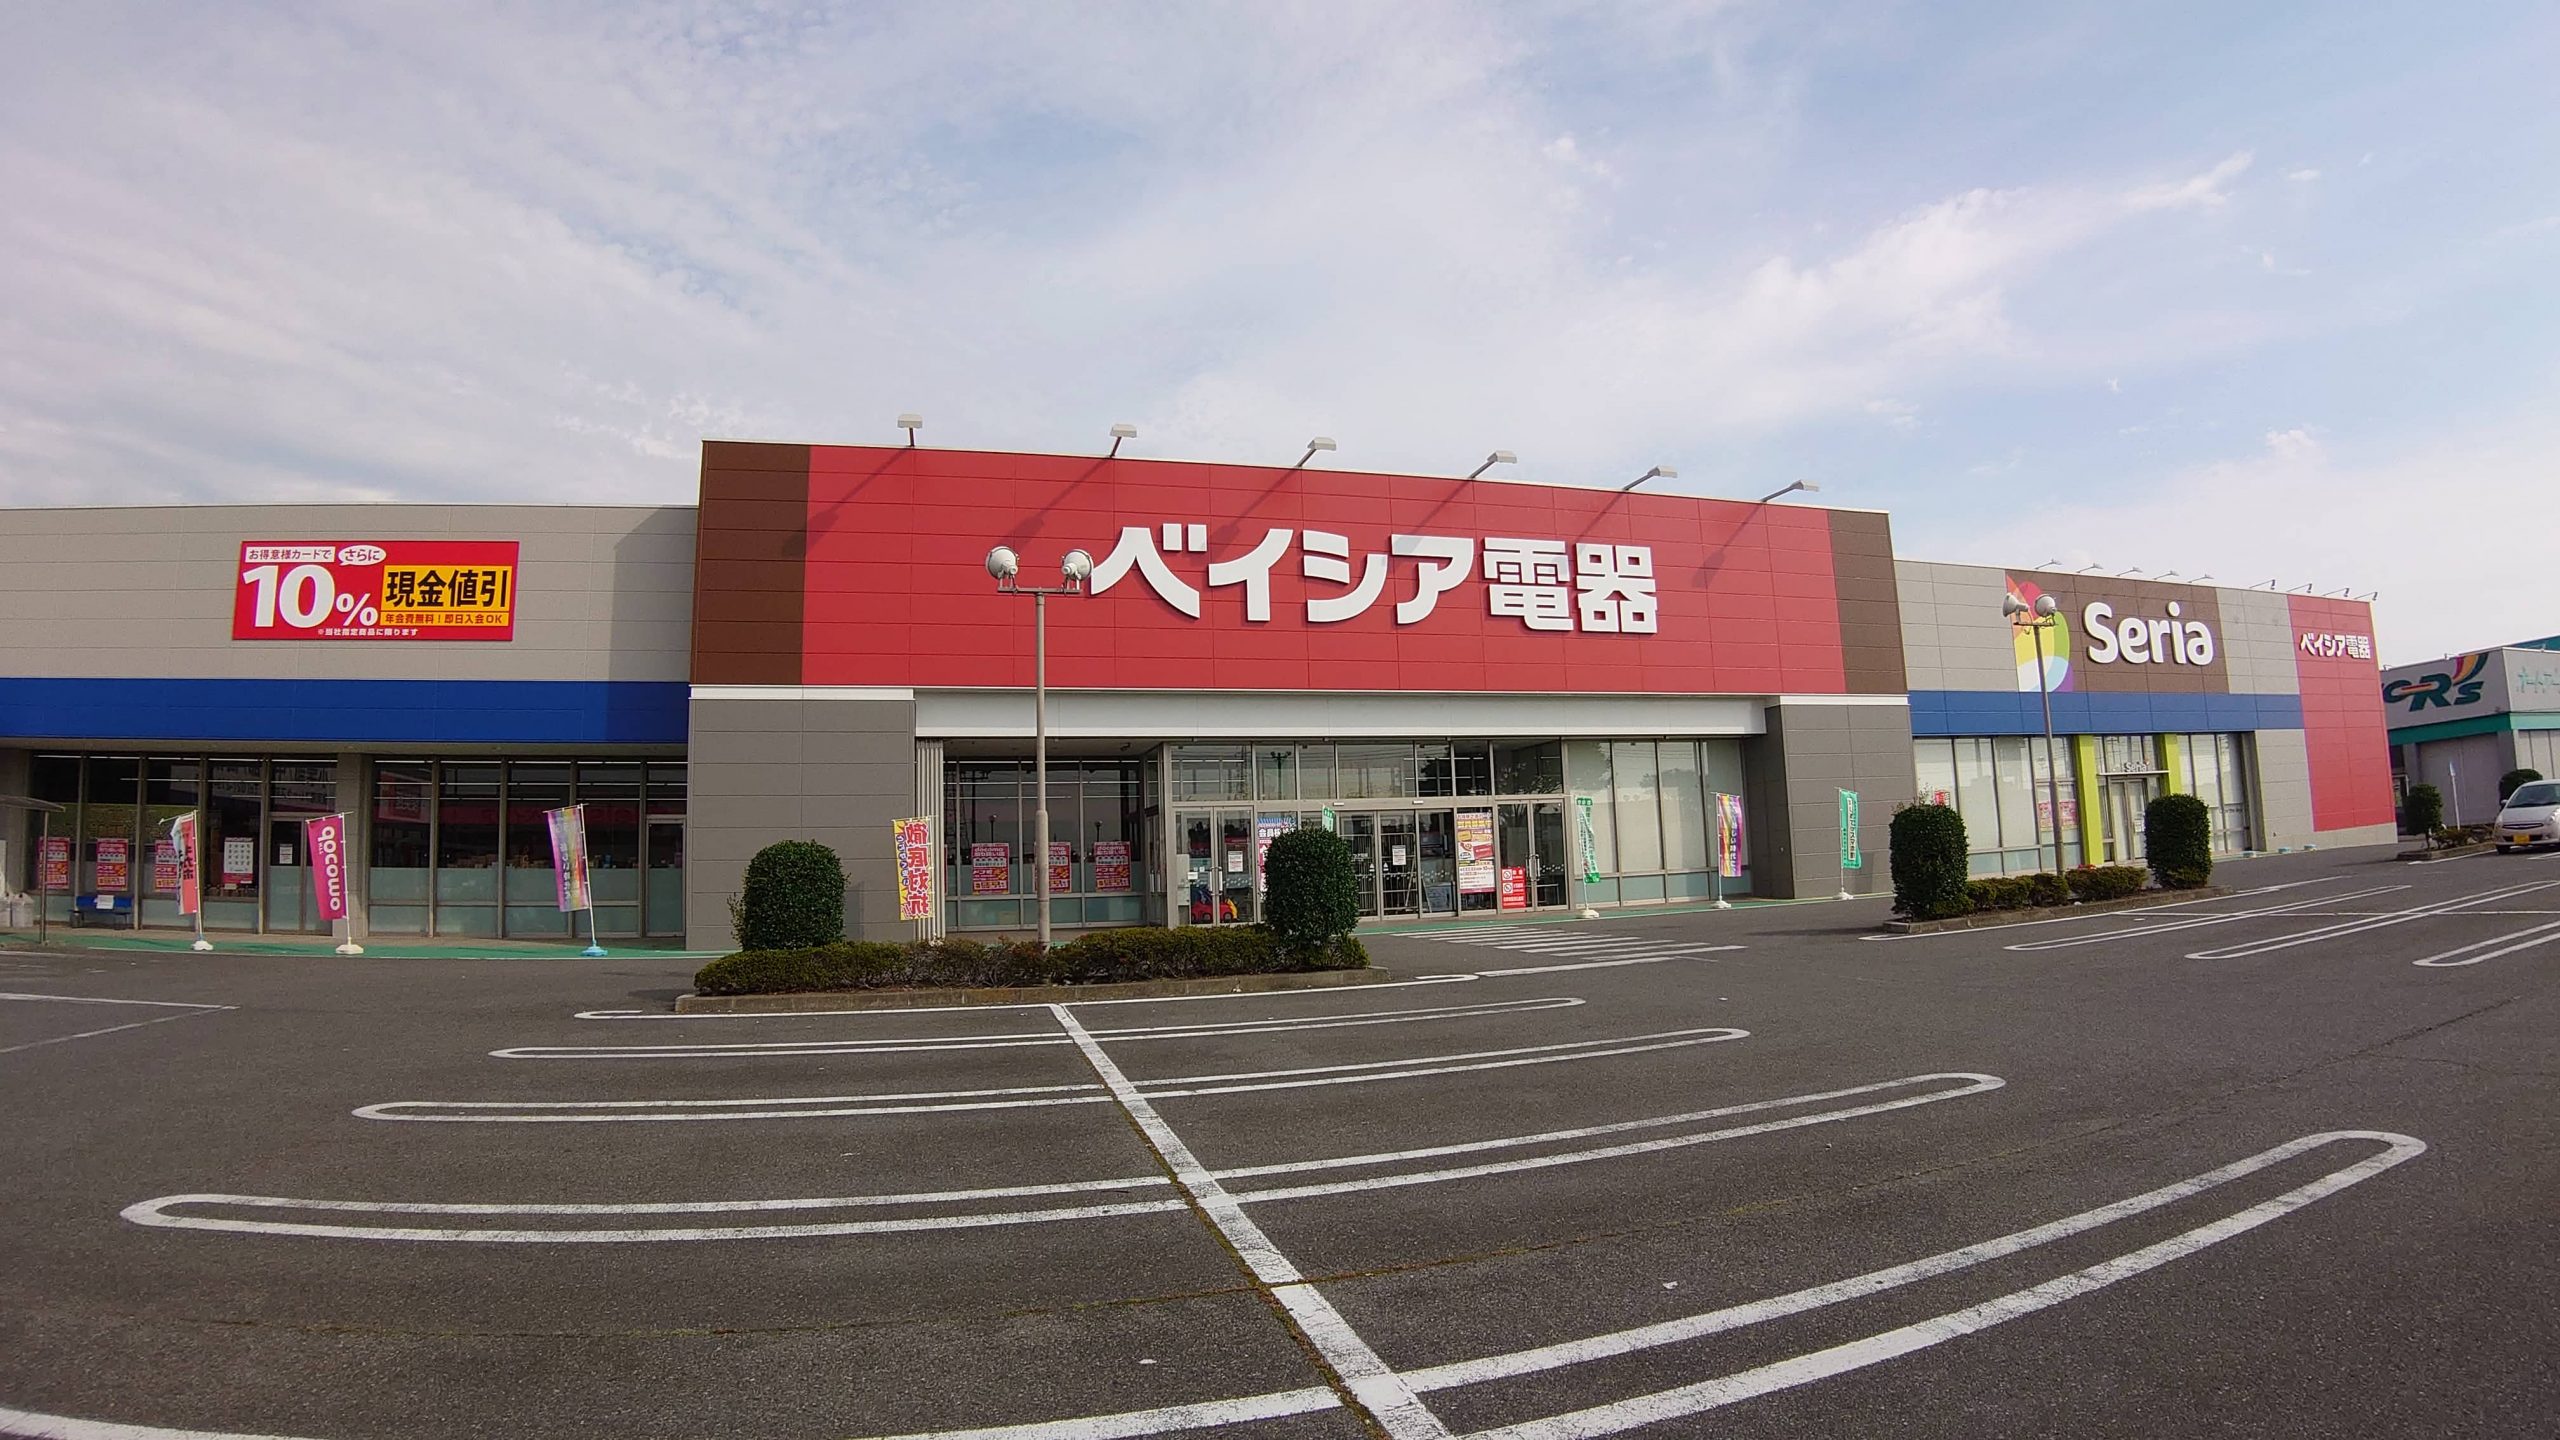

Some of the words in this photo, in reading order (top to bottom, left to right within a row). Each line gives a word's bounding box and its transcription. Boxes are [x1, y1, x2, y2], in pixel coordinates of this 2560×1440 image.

[248, 549, 332, 560] お得意様カードで
[345, 549, 380, 561] さらに
[243, 564, 378, 628] 10%
[386, 569, 508, 608] 現金値引
[1091, 523, 1657, 633] ベイシア電器
[2084, 601, 2214, 666] Seria
[2300, 633, 2371, 659] ベイシア電器
